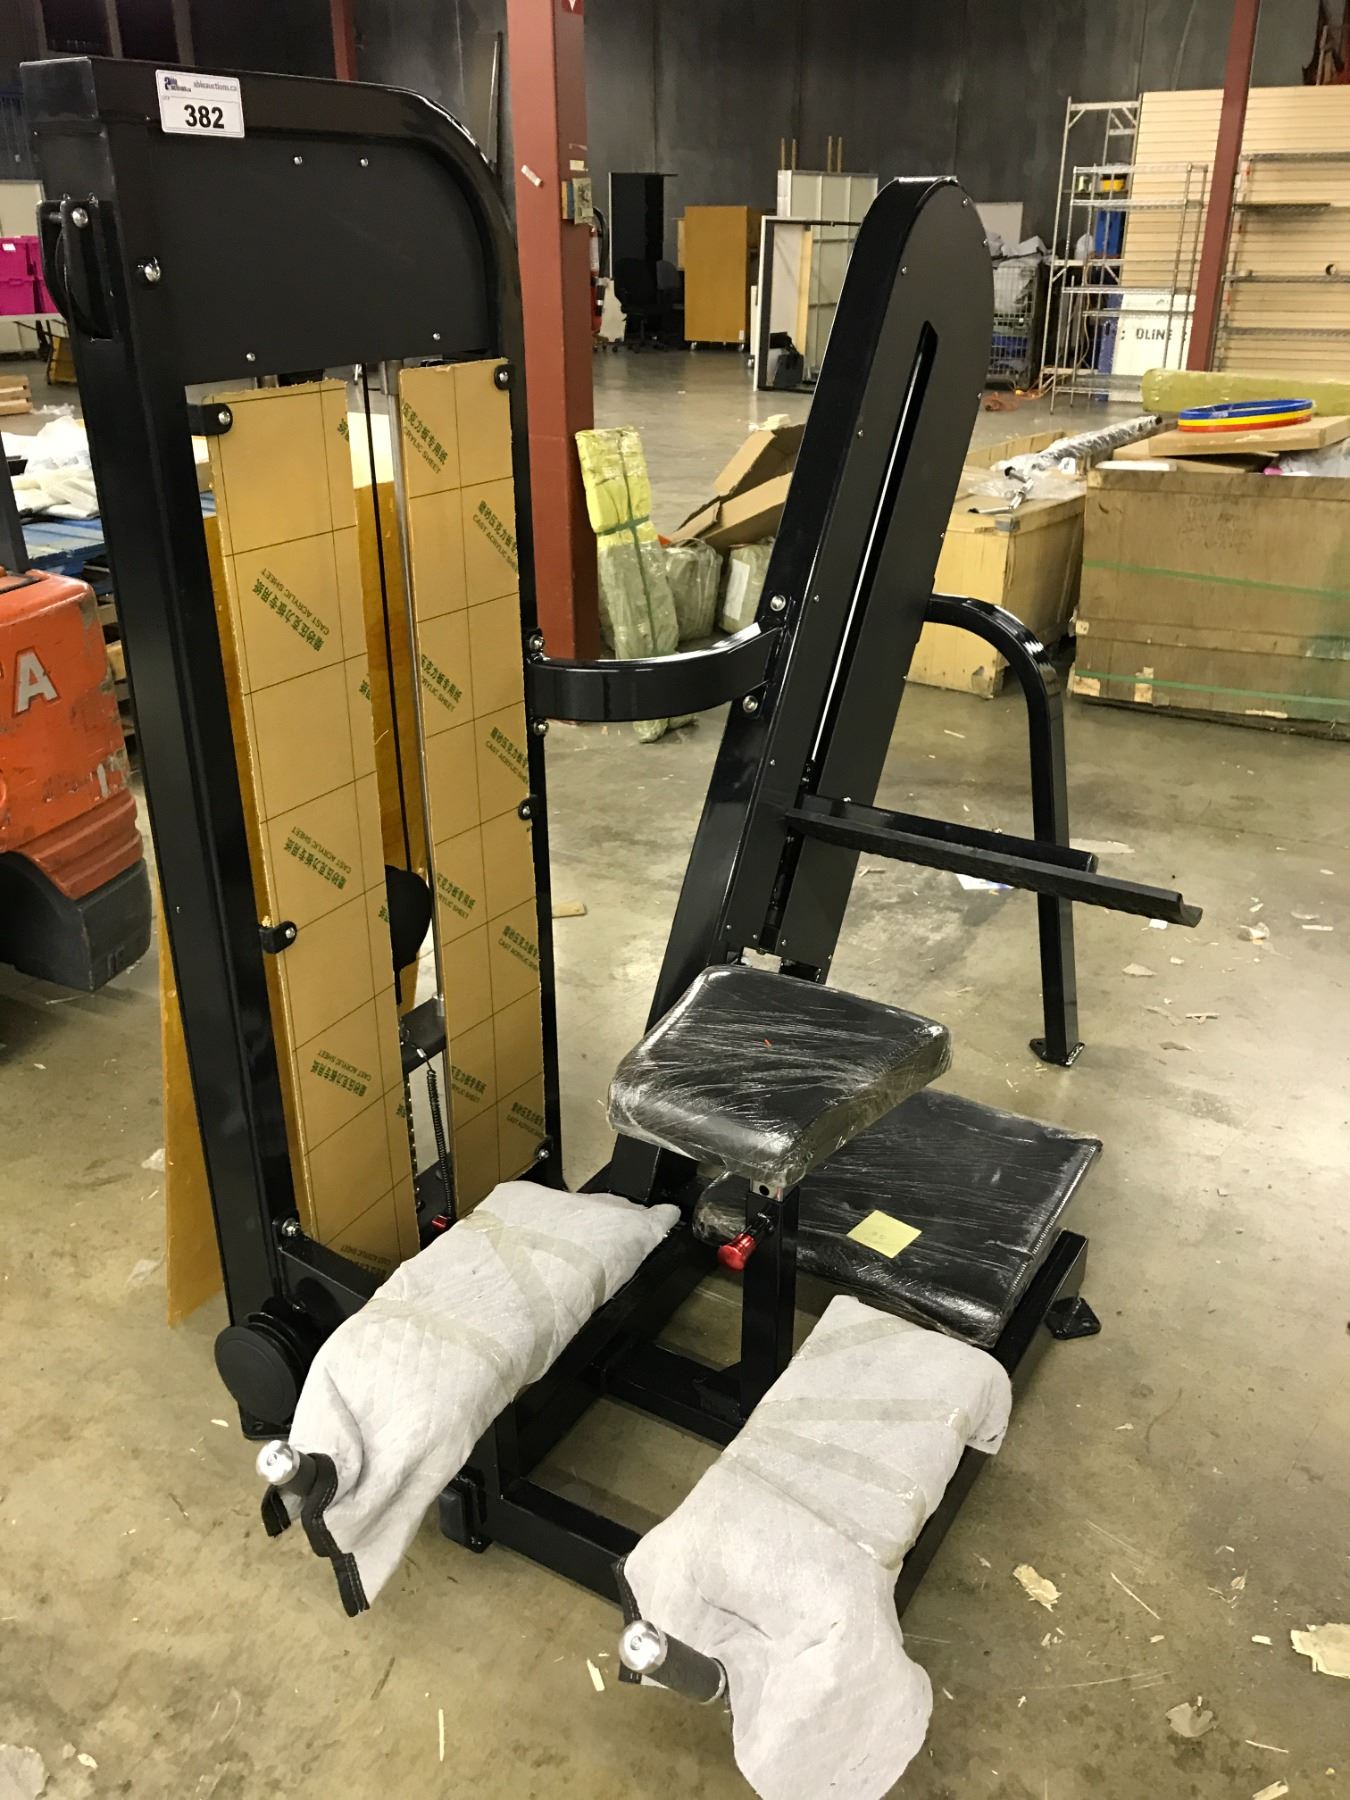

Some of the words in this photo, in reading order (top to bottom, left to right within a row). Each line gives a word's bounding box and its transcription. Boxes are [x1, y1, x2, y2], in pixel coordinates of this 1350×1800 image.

[184, 103, 225, 129] 382
[261, 567, 284, 592] SHEET
[283, 588, 313, 618] ACRYLIC
[312, 616, 330, 636] CAST
[1, 648, 60, 715] A
